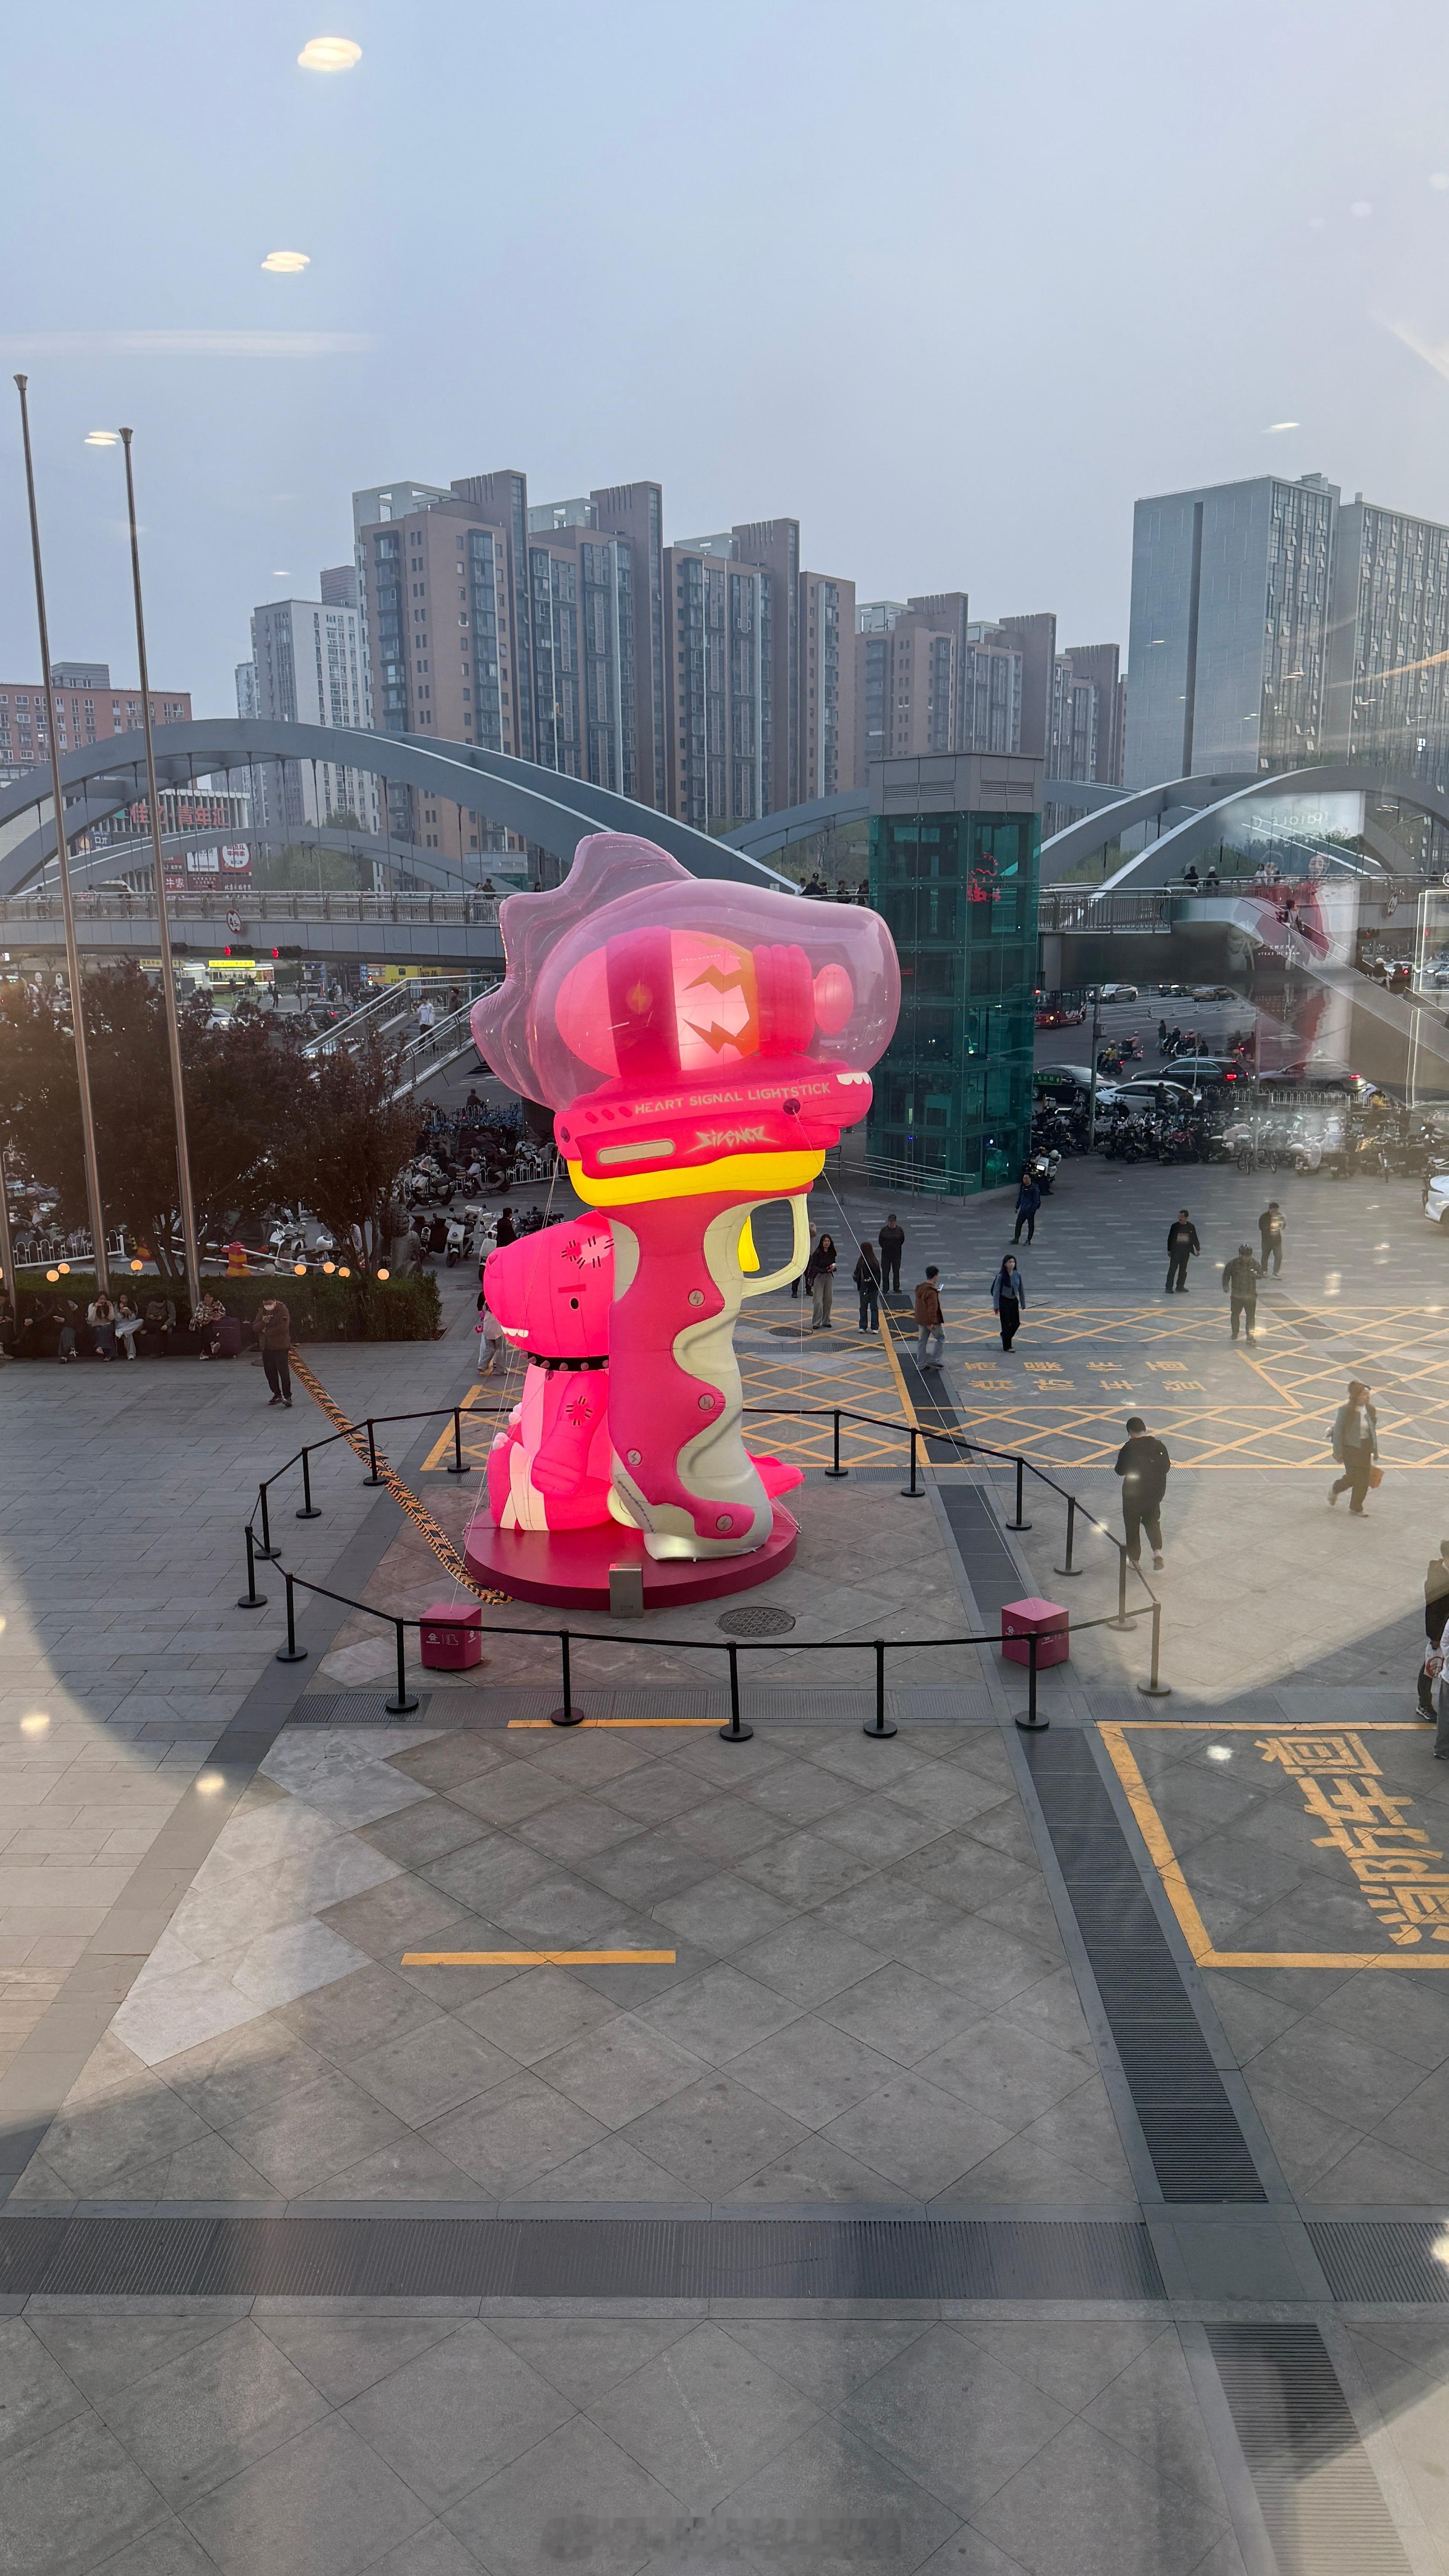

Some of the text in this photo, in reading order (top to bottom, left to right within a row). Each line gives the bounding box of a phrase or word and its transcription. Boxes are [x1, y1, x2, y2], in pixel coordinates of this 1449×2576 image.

[635, 1082, 830, 1114] HEART SIGNAL LIGHTSTICK
